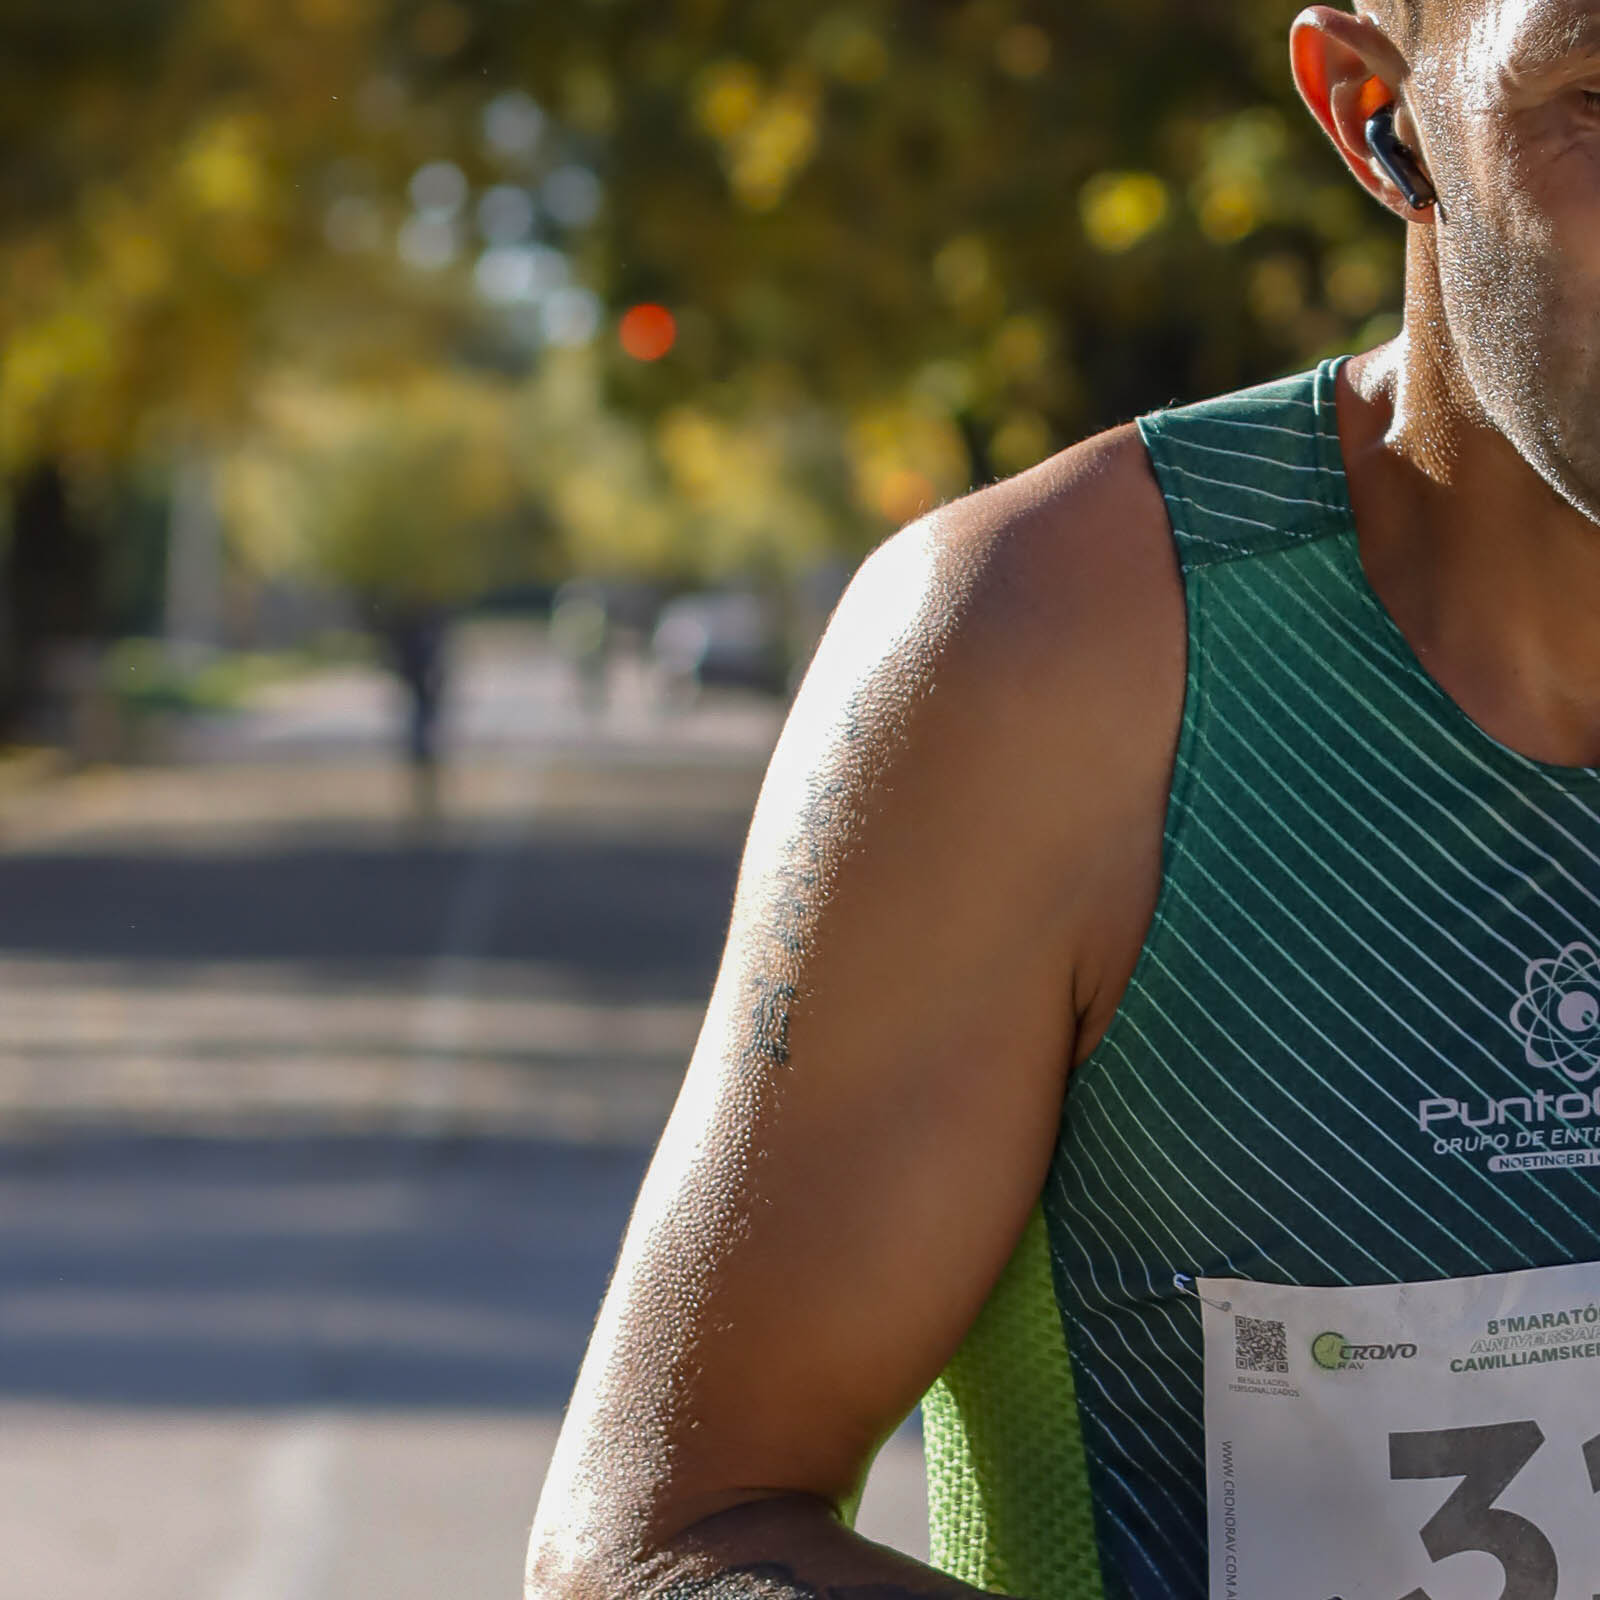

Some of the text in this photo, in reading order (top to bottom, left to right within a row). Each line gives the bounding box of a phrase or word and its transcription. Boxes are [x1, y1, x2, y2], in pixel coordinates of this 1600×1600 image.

[1433, 1132, 1511, 1155] GRUPO
[1515, 1130, 1545, 1147] DE
[1499, 1152, 1586, 1169] NOETINGER
